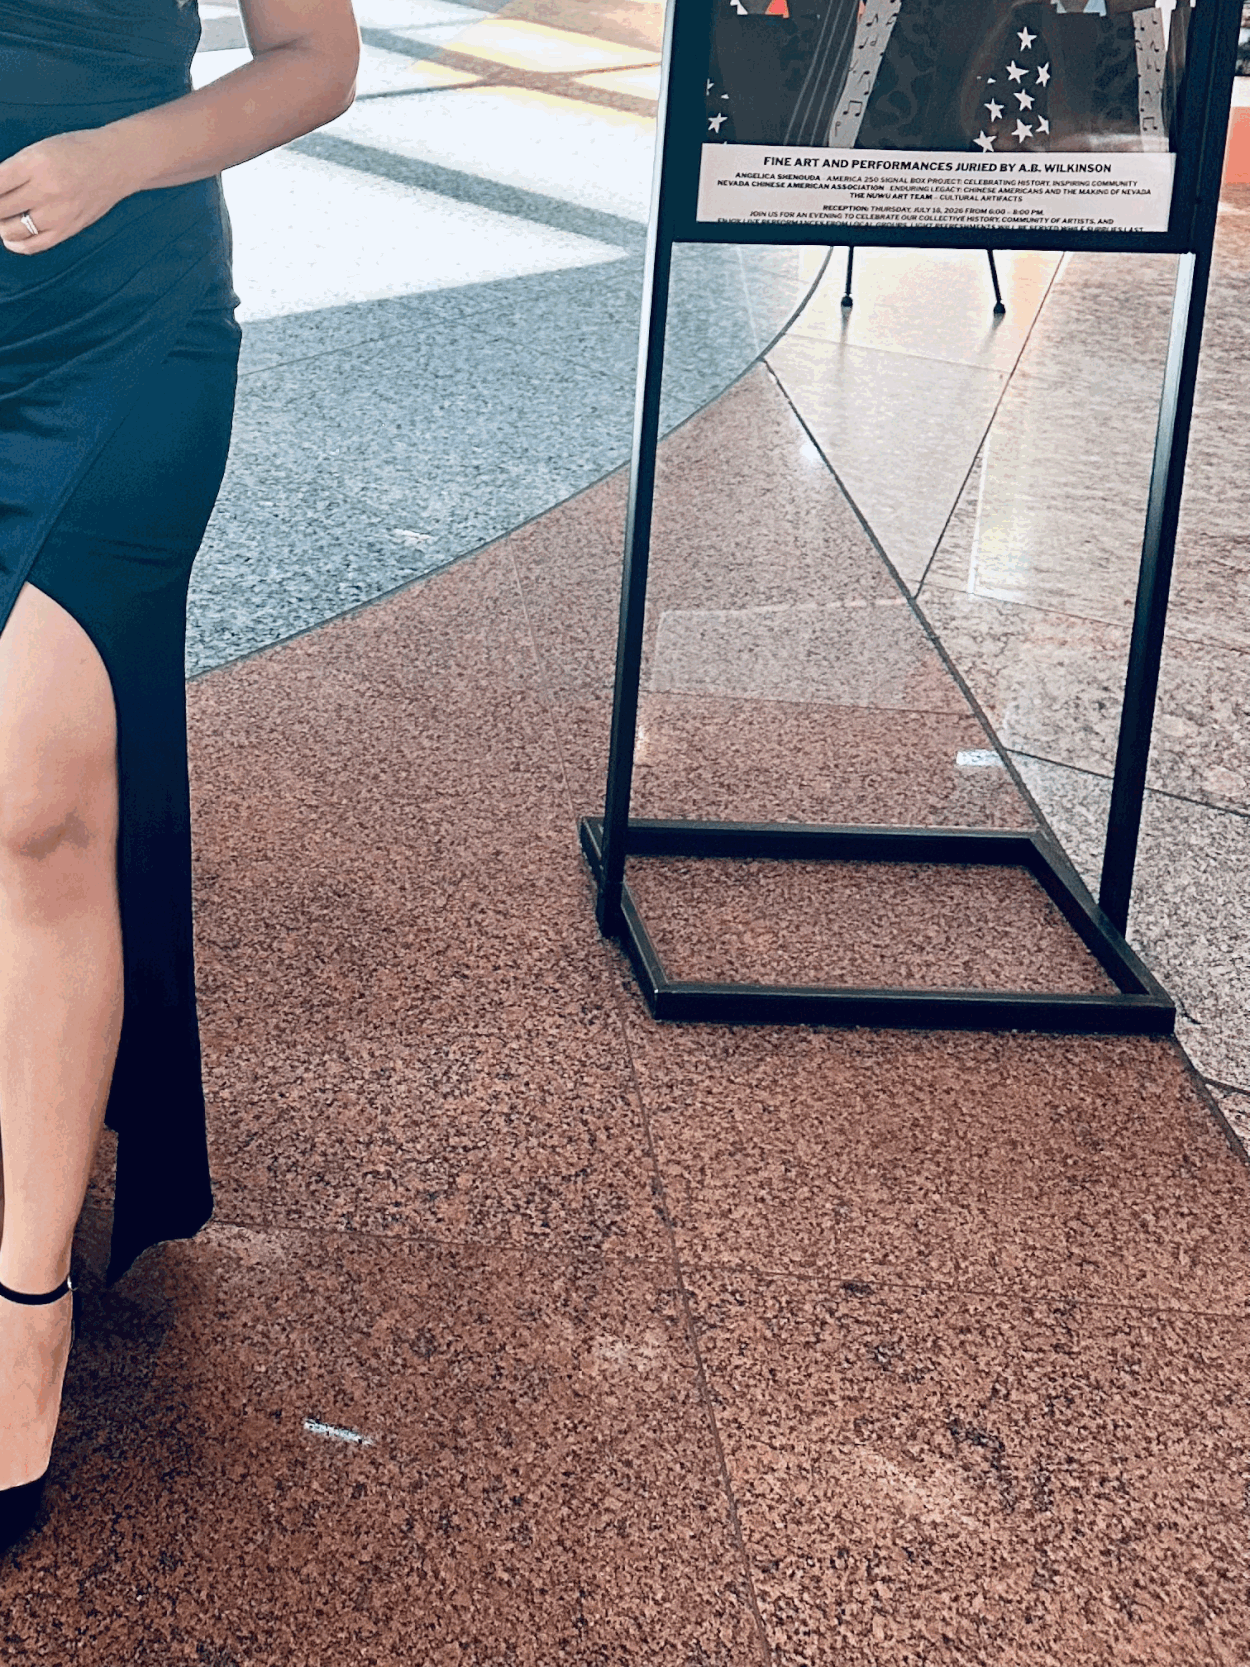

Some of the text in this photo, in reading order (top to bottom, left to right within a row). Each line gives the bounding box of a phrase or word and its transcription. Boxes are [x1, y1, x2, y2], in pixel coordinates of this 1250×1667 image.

[763, 156, 1112, 173] FINE ART AND PERFORMANCES JURIED BY A.B. WILKINSON
[735, 172, 776, 180] ANGELICA
[918, 214, 966, 222] COLLECTIVE
